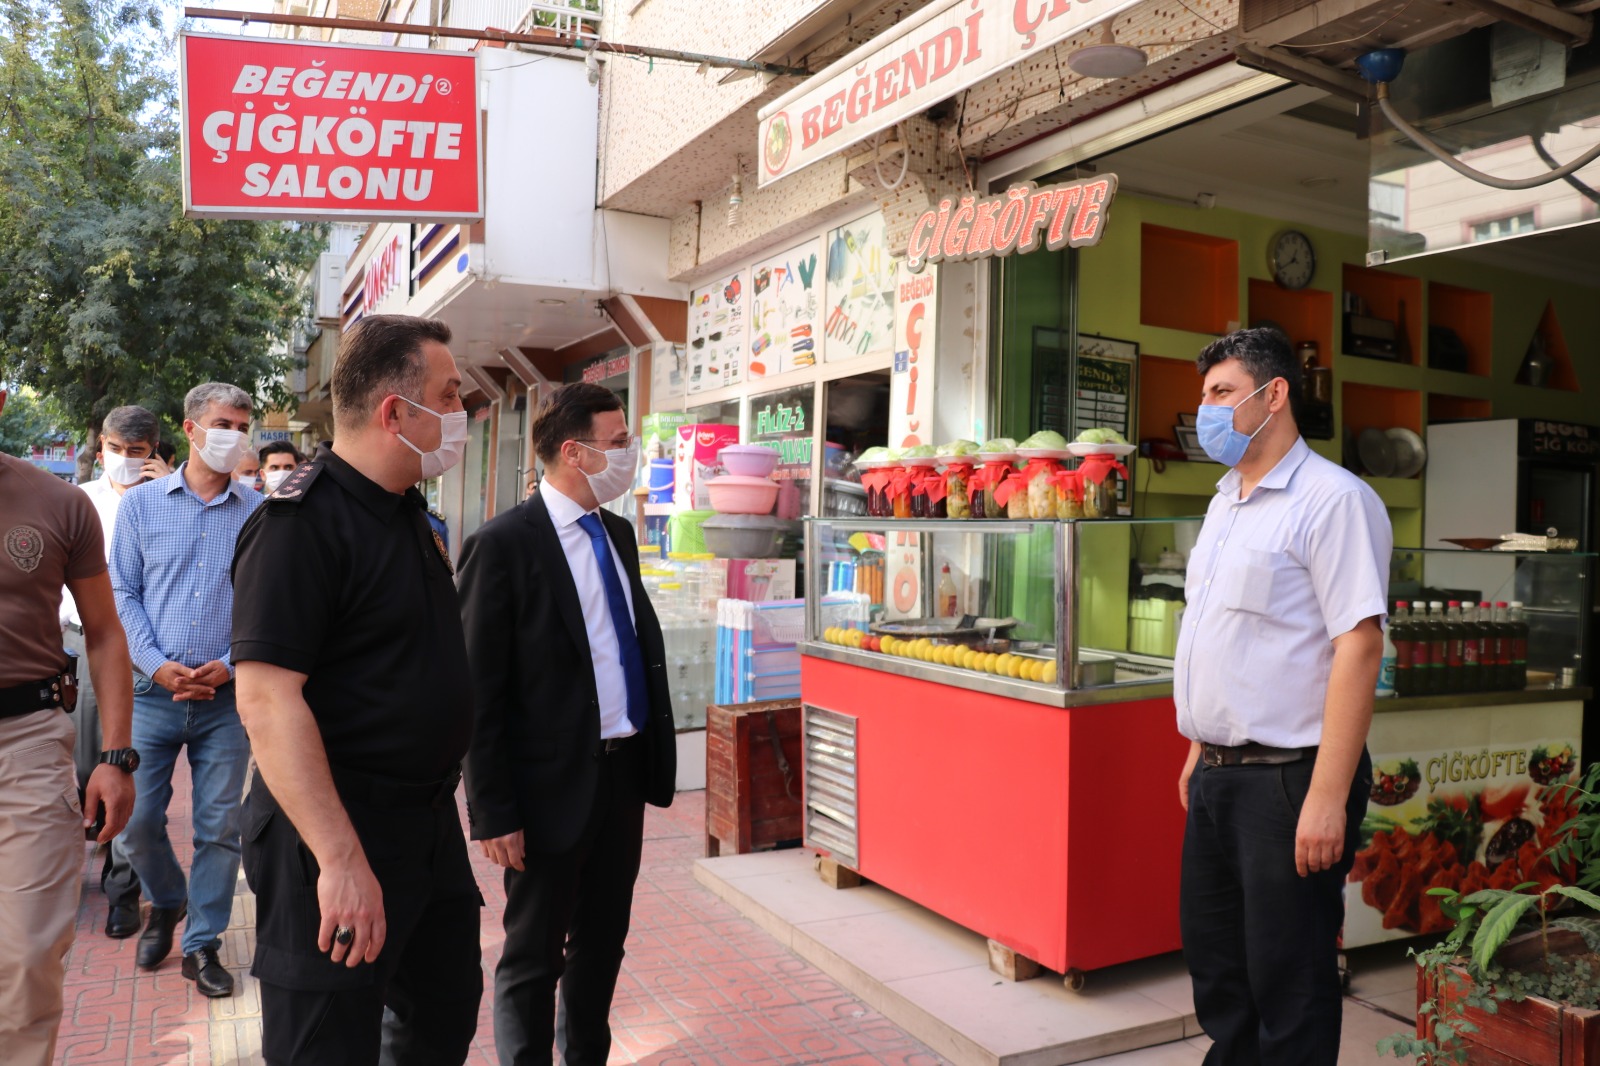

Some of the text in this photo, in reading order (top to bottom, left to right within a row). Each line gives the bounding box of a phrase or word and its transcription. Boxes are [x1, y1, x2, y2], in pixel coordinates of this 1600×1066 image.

[801, 0, 984, 151] BEĞENDİ
[202, 102, 463, 164] ÇİĞKÖFTE
[240, 165, 433, 202] SALONU
[907, 179, 1112, 268] ÇİĞKÖFTE
[260, 431, 295, 441] HASRET
[1425, 748, 1527, 794] ÇİĞKÖFTE
